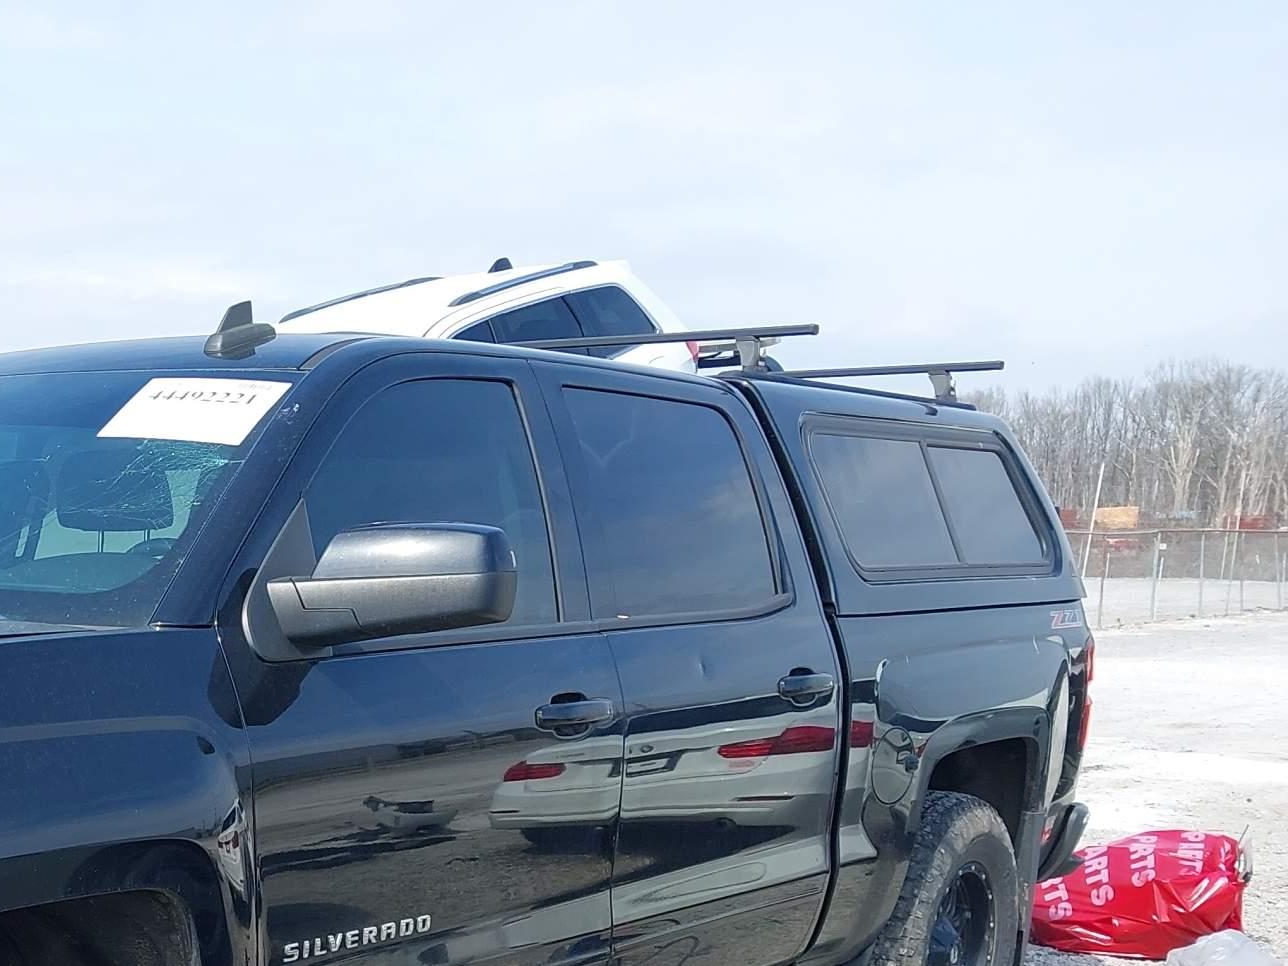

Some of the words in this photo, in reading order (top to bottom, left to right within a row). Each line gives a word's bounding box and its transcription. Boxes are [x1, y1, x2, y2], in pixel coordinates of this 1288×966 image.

[149, 390, 258, 405] 44492221
[1082, 844, 1115, 907] ARTS
[282, 913, 432, 963] SILVERADO
